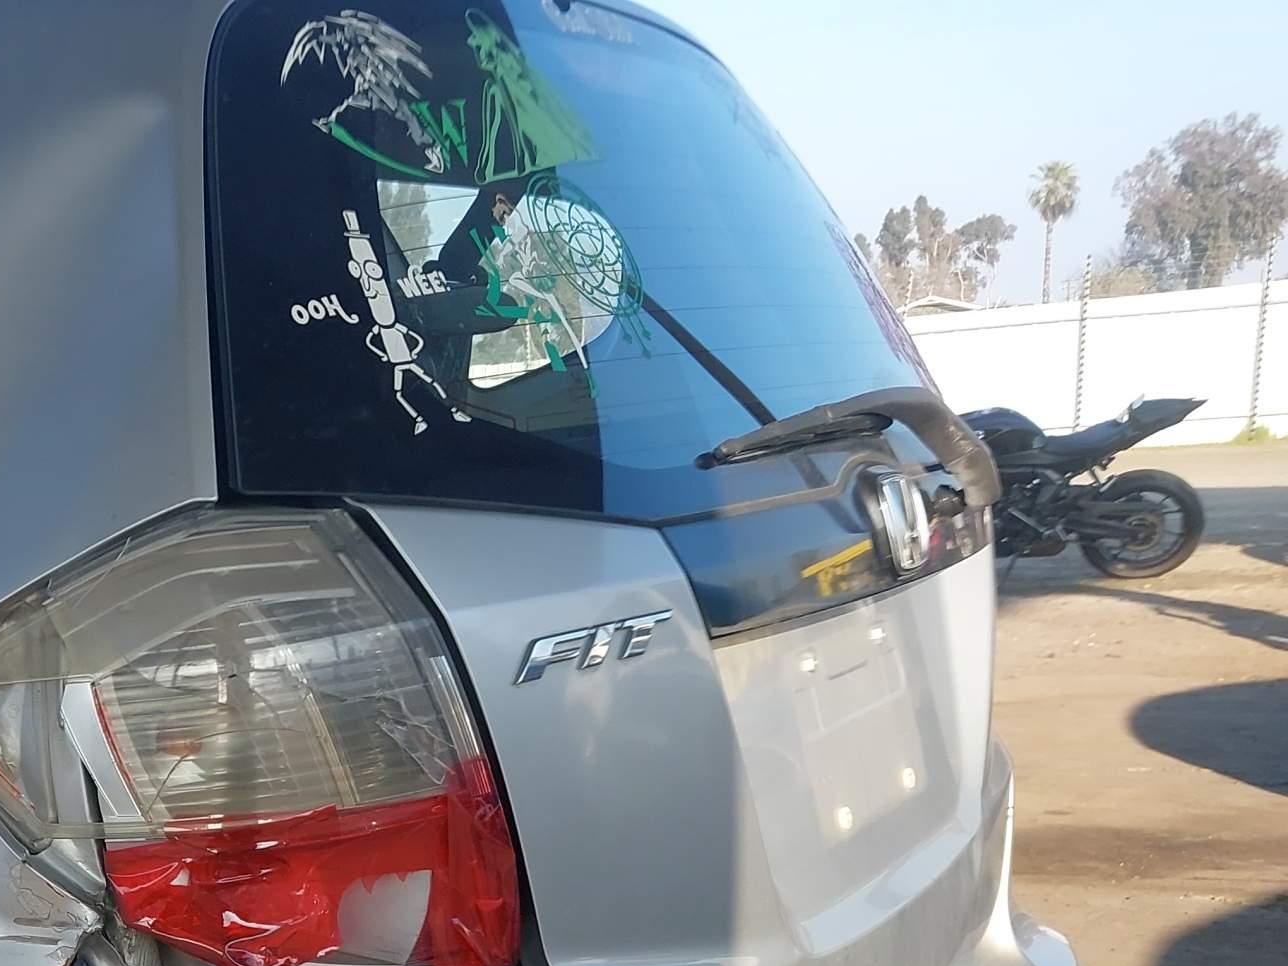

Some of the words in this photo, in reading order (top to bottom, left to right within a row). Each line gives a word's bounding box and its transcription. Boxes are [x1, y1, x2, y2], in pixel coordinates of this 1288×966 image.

[396, 267, 452, 299] WEE!
[290, 294, 360, 325] OOH
[512, 608, 672, 685] FIT
